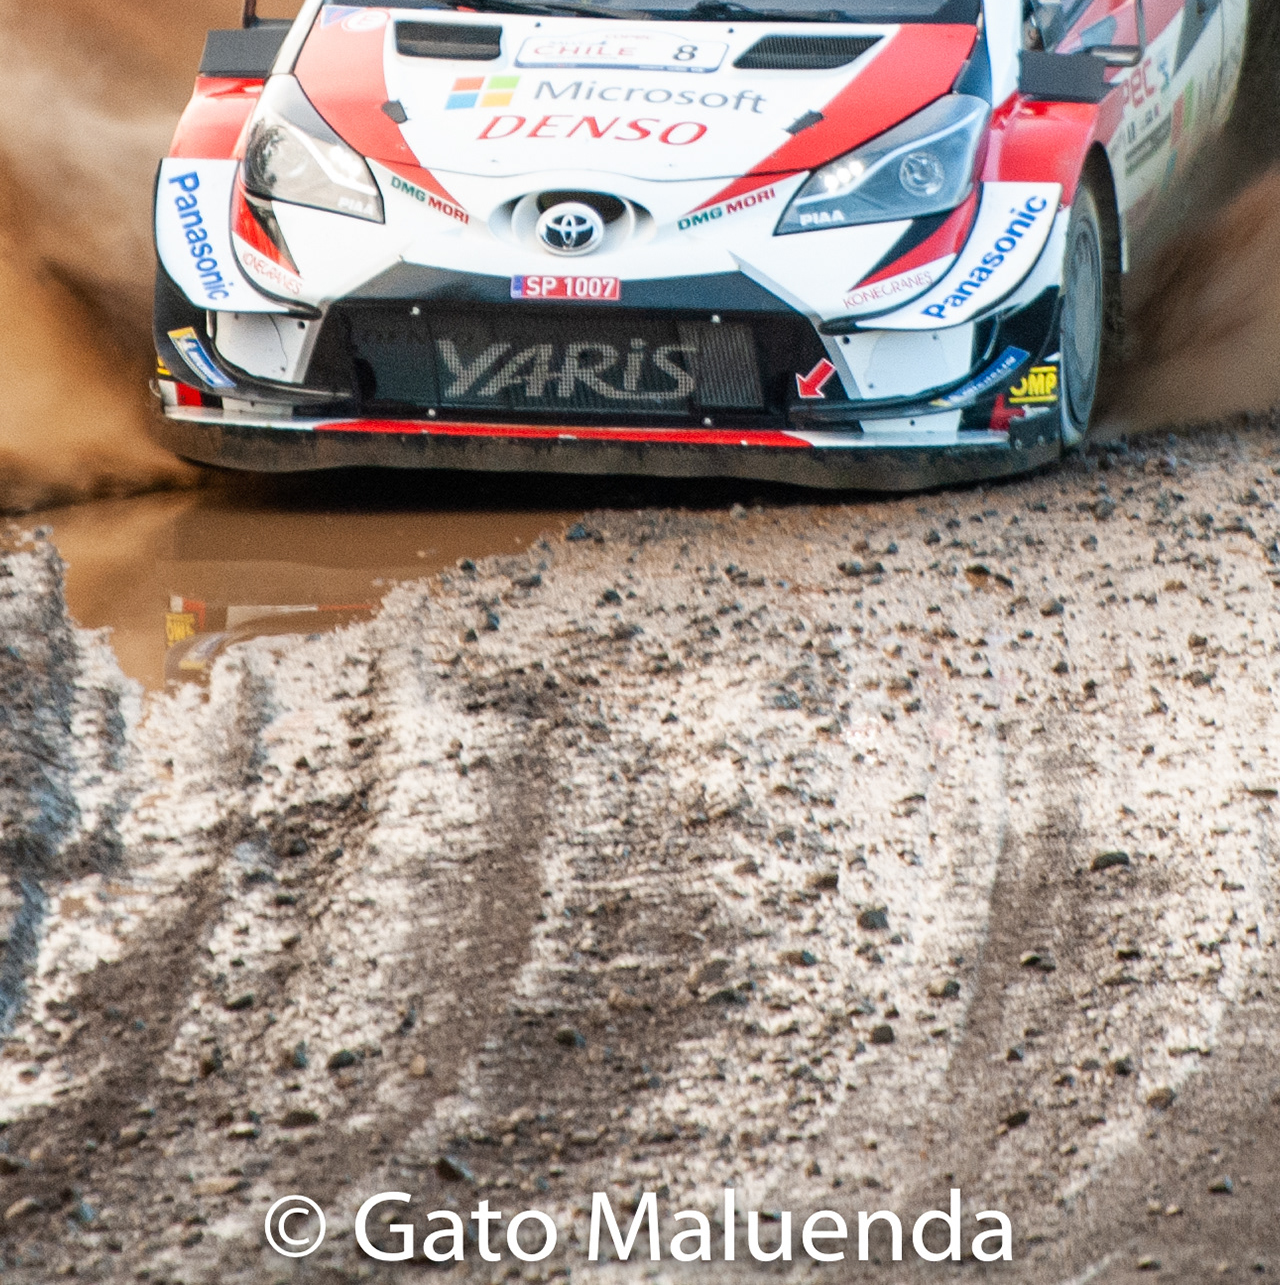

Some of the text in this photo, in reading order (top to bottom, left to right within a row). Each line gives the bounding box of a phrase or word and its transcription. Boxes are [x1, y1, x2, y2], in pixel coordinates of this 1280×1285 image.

[533, 44, 699, 61] CHILE 8
[533, 80, 767, 114] Microsoft
[476, 115, 708, 146] DENSO
[391, 175, 470, 224] DMG MORI
[677, 187, 776, 231] DMG MORI
[798, 209, 846, 226] PIAA
[168, 170, 234, 301] Panasonic
[920, 195, 1048, 319] Panasonic
[525, 276, 616, 298] SP 1007
[842, 270, 934, 309] KONECRANES
